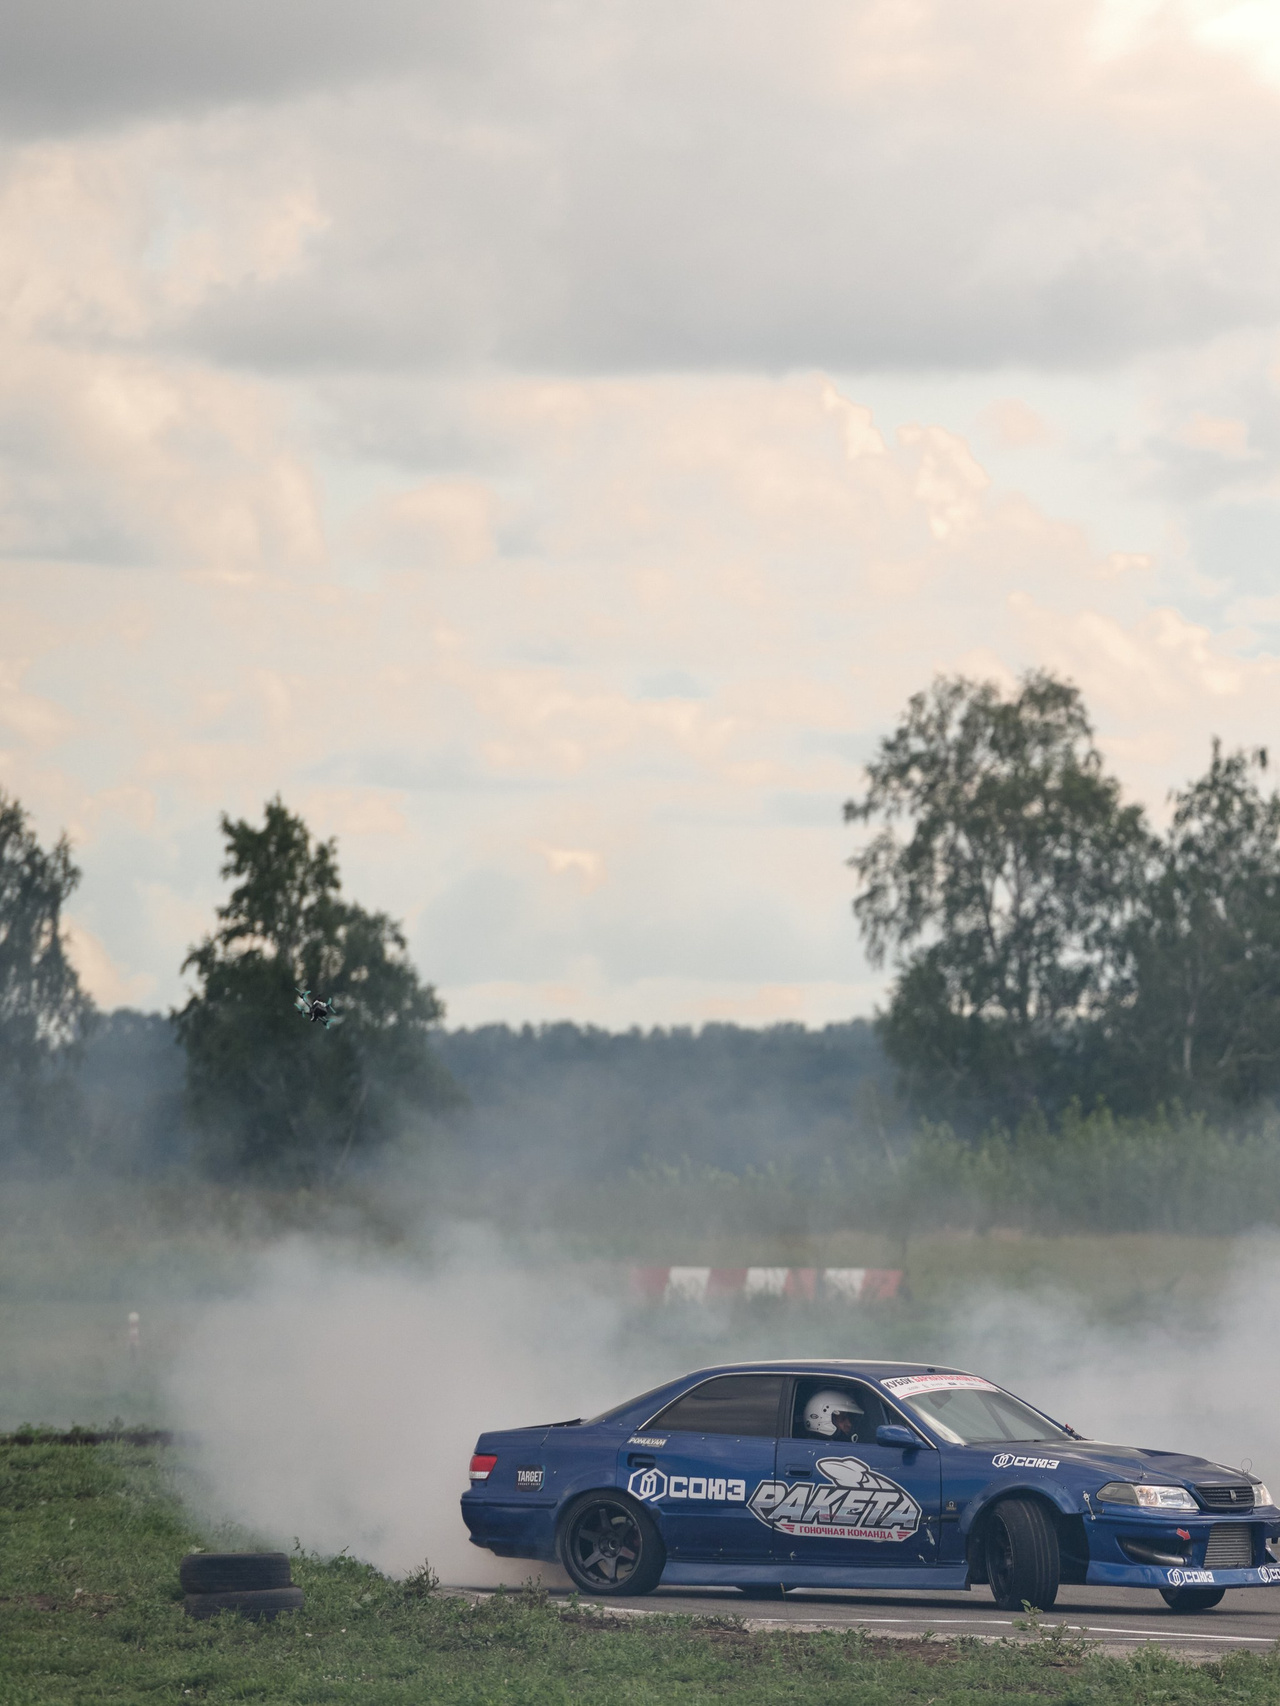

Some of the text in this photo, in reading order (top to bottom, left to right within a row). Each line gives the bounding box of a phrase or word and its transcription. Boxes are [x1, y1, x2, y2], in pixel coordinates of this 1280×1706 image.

[1013, 1456, 1060, 1470] СОЮЗ
[517, 1470, 544, 1482] TARGET
[669, 1476, 746, 1501] СОЮЗ
[750, 1482, 919, 1529] РАКЕТА
[800, 1526, 893, 1539] ГОНОЧНАЯ КОМАНДА
[1183, 1571, 1214, 1583] СОЮЗ
